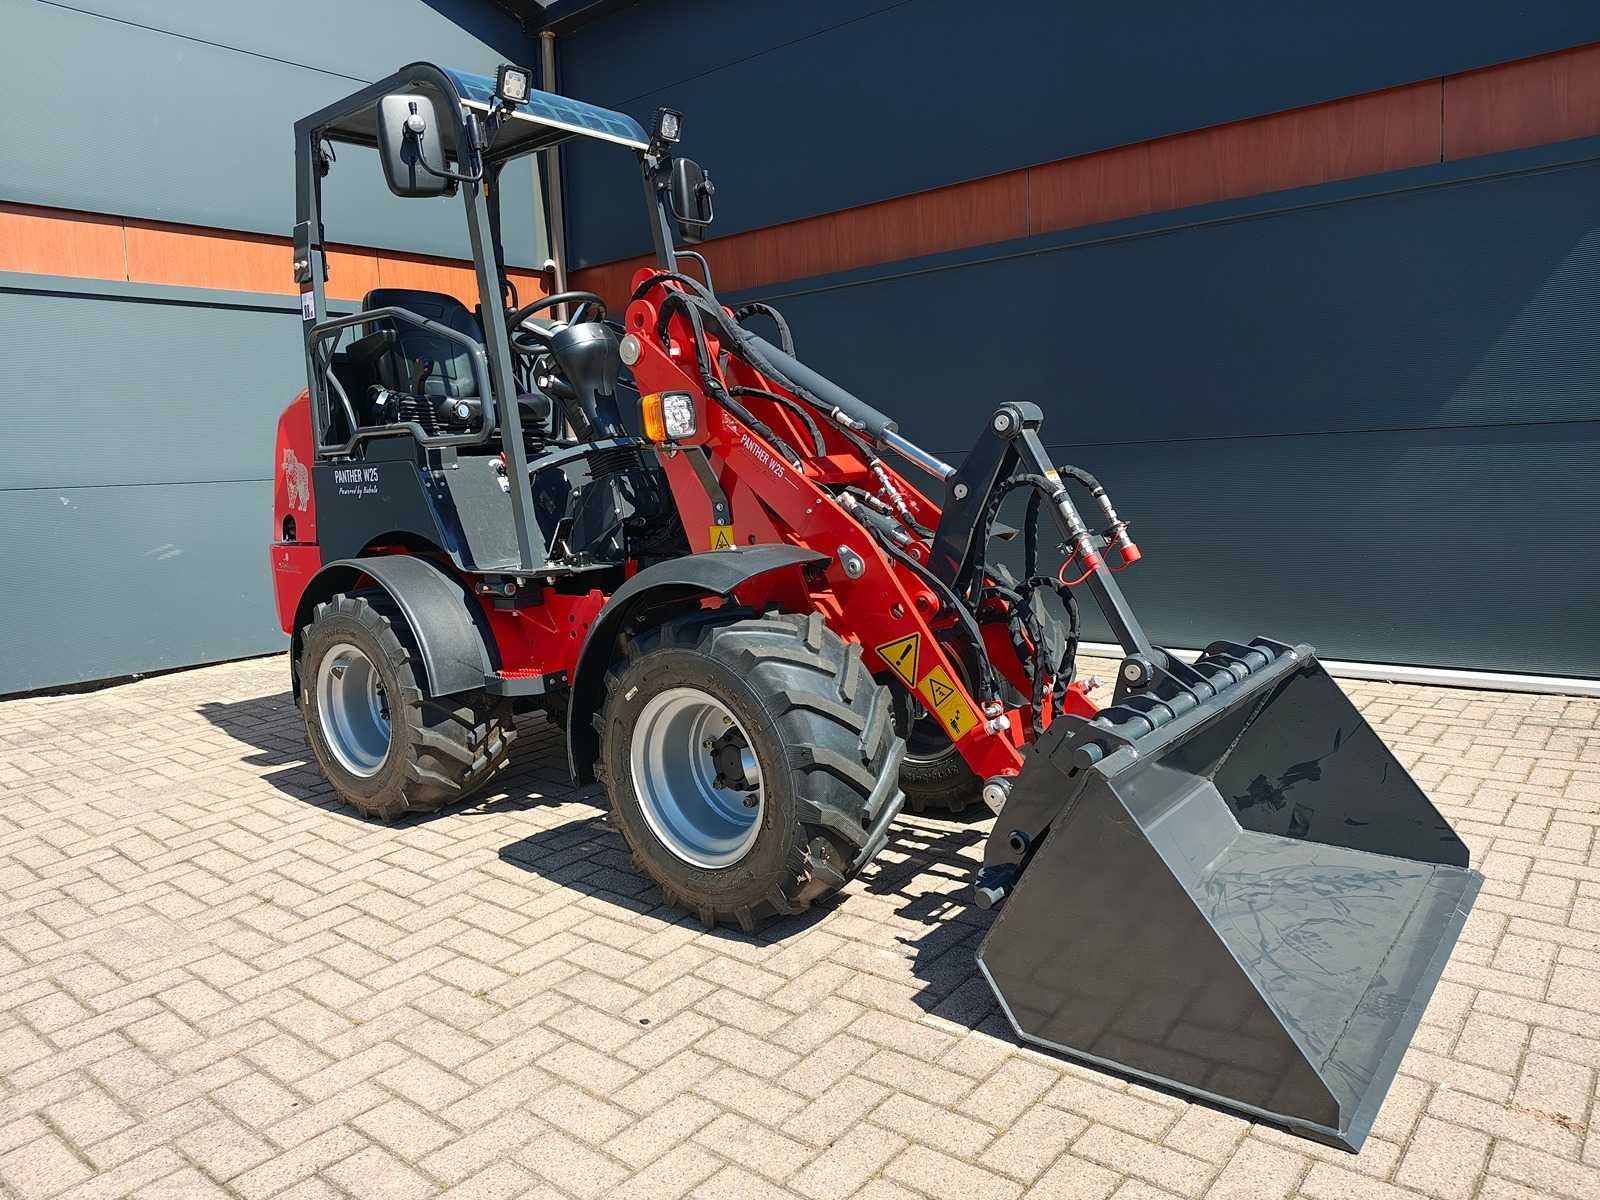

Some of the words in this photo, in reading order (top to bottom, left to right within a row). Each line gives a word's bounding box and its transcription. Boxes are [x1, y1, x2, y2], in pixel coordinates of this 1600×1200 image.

[740, 434, 769, 465] PANTHER
[768, 458, 785, 478] W25
[334, 469, 363, 483] PANTHER
[363, 467, 378, 481] W25
